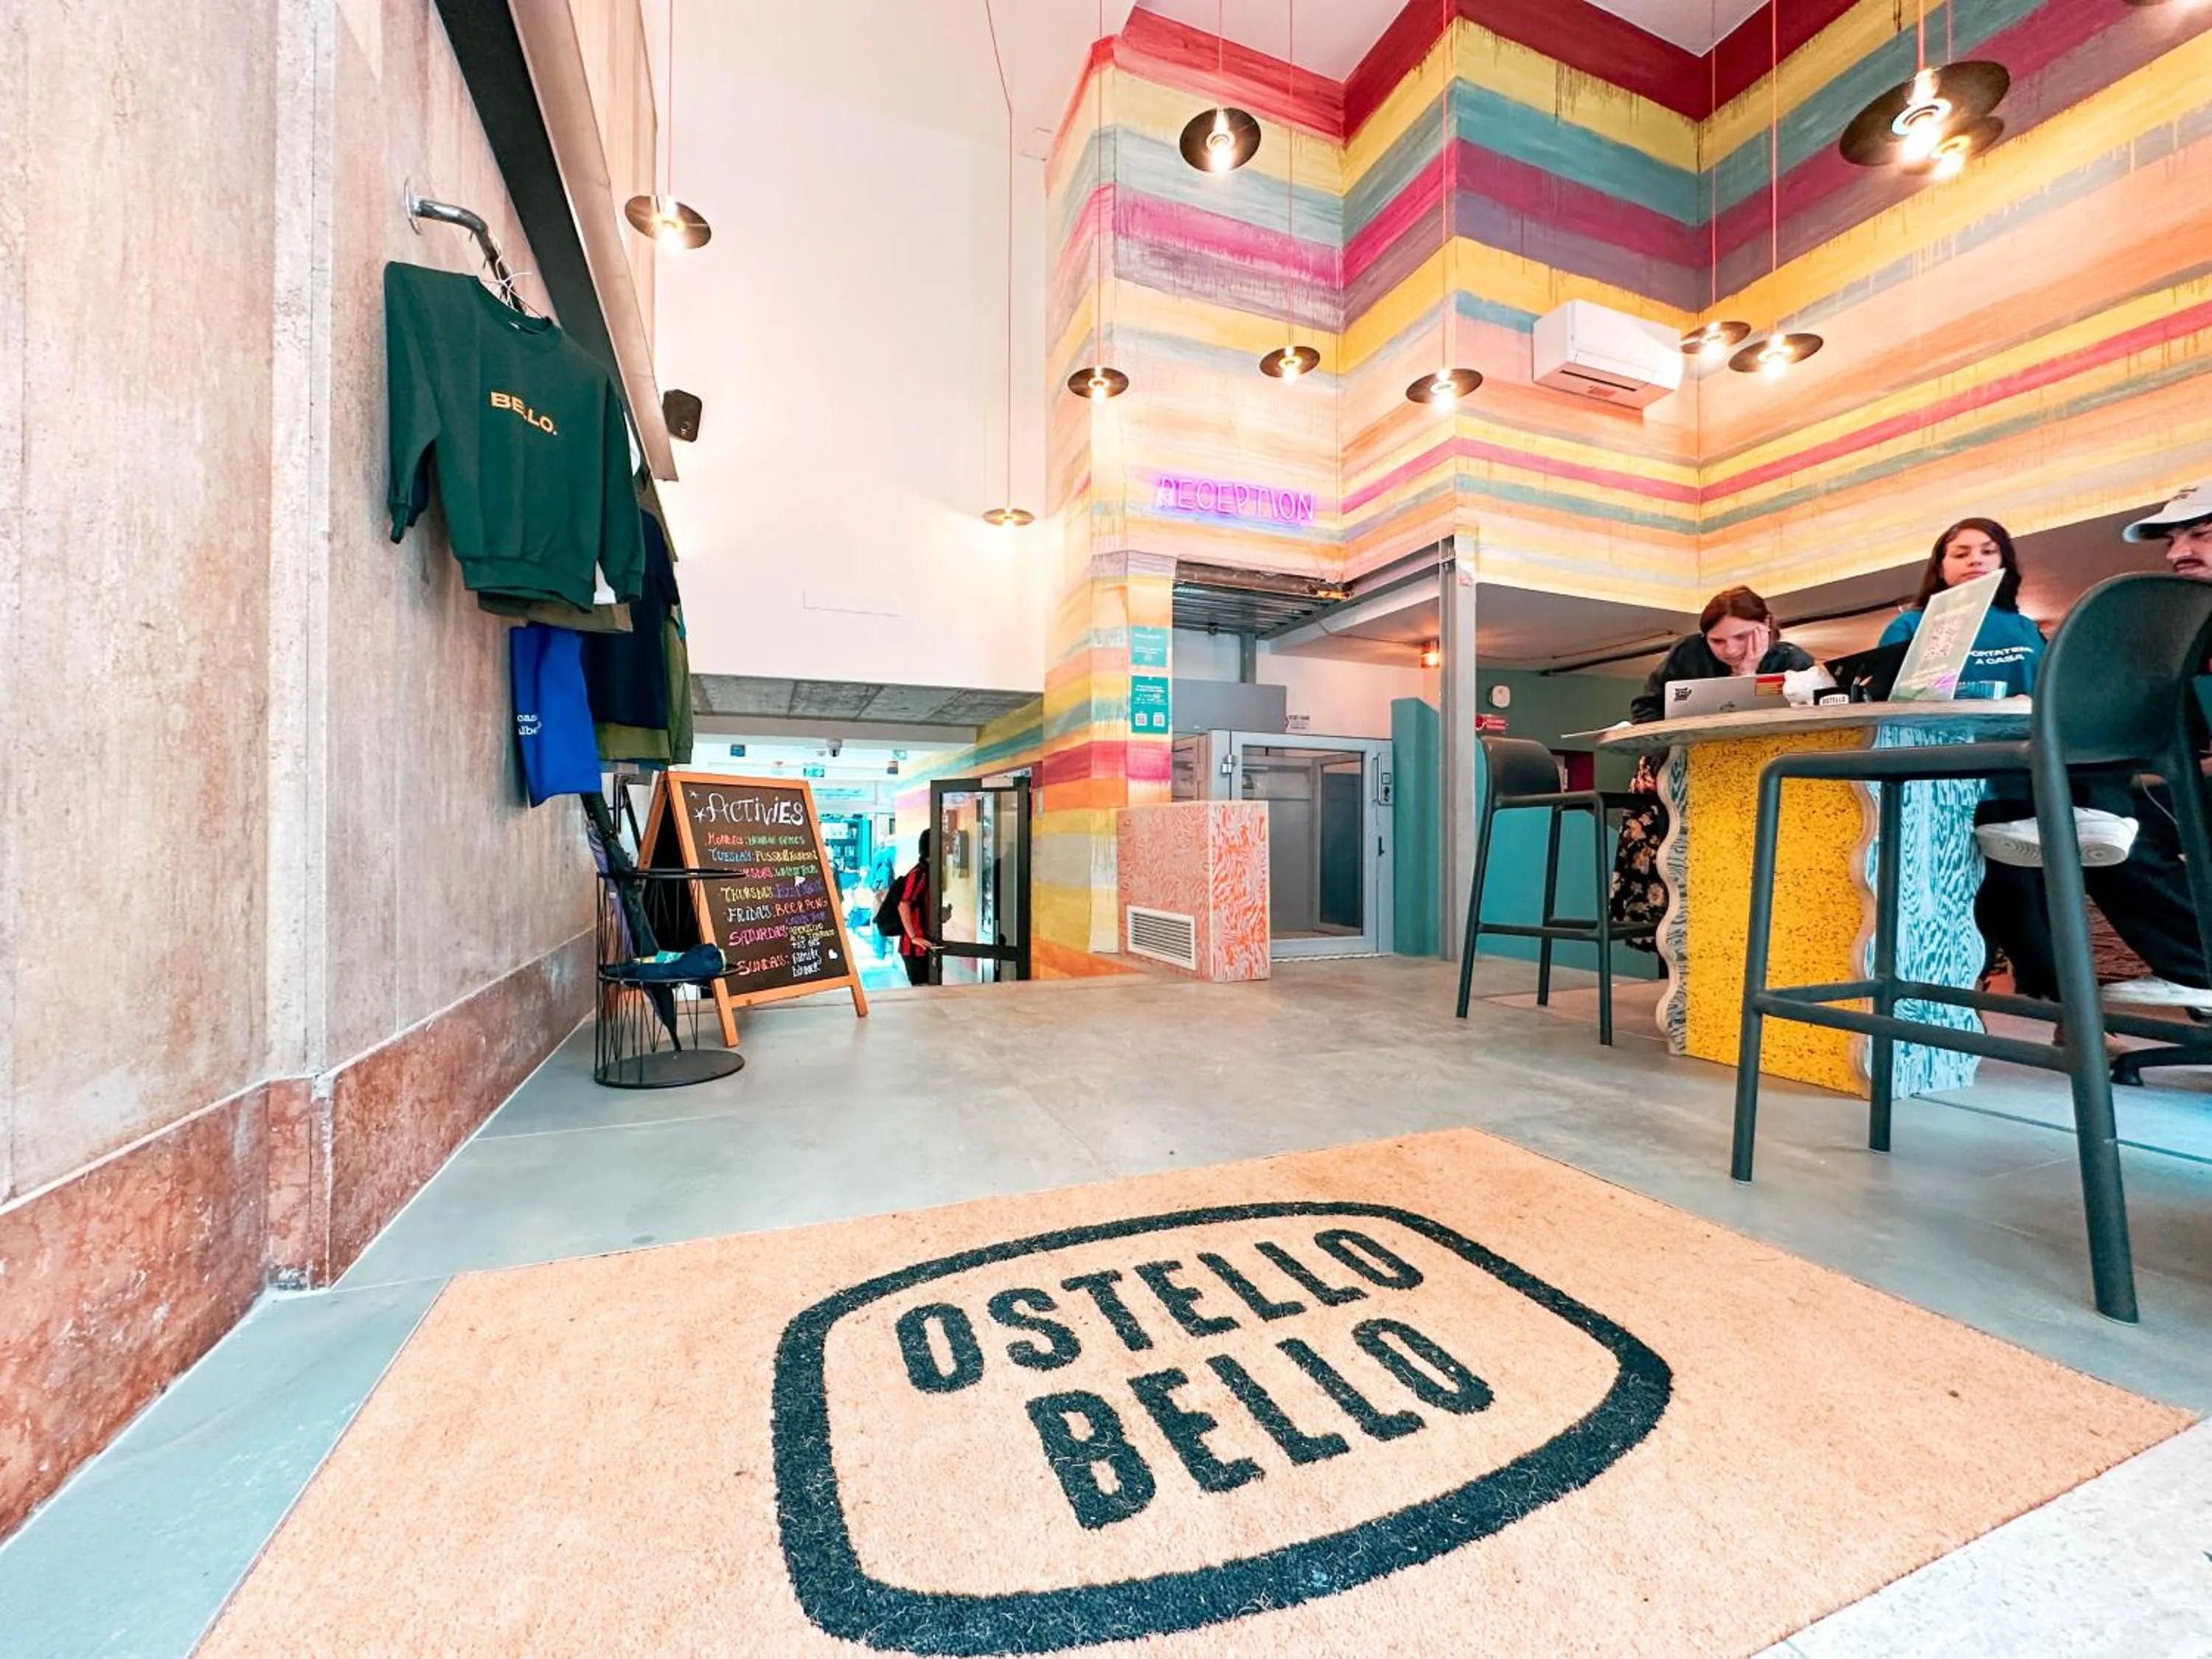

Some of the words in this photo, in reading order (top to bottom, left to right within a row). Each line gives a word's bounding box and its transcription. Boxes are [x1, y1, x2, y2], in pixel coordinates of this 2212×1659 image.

[490, 392, 557, 435] BELO.
[1156, 476, 1315, 521] RECEPTION
[896, 1228, 1424, 1394] OSTELLO
[1026, 1318, 1495, 1530] BELLO
